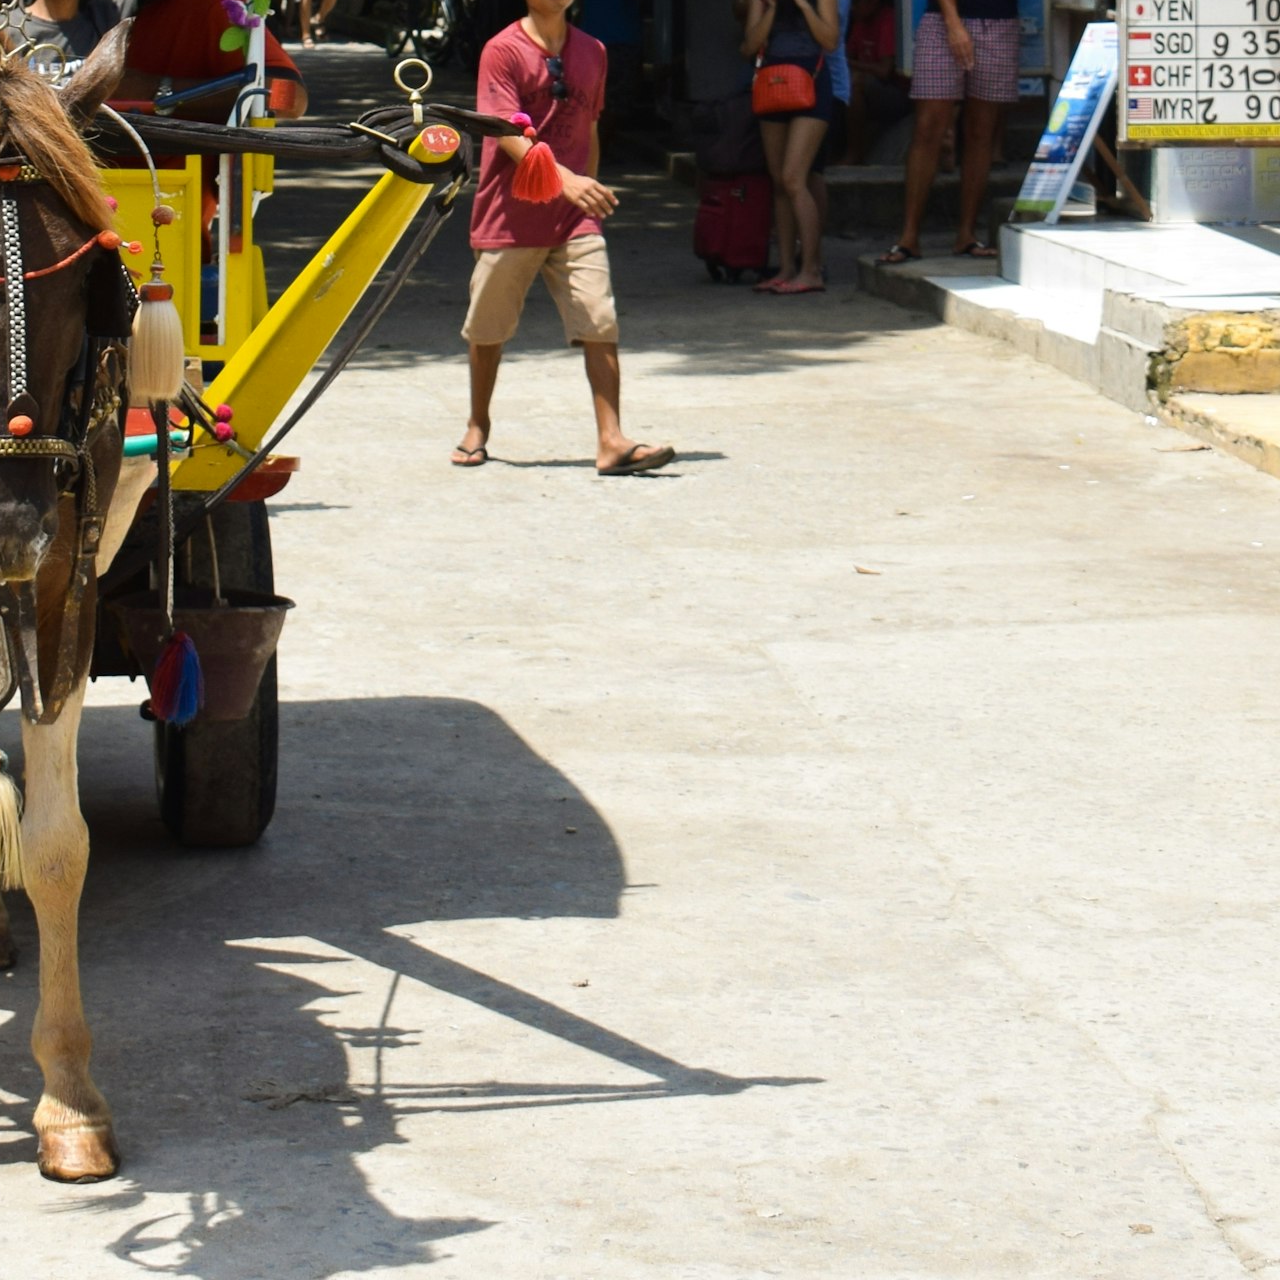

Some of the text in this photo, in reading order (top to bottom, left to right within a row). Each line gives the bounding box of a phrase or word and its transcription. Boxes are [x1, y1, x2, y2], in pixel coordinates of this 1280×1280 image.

[1153, 0, 1193, 21] YEN
[1154, 32, 1193, 54] SGD
[1153, 65, 1192, 87] CHF
[1152, 98, 1194, 119] MYR
